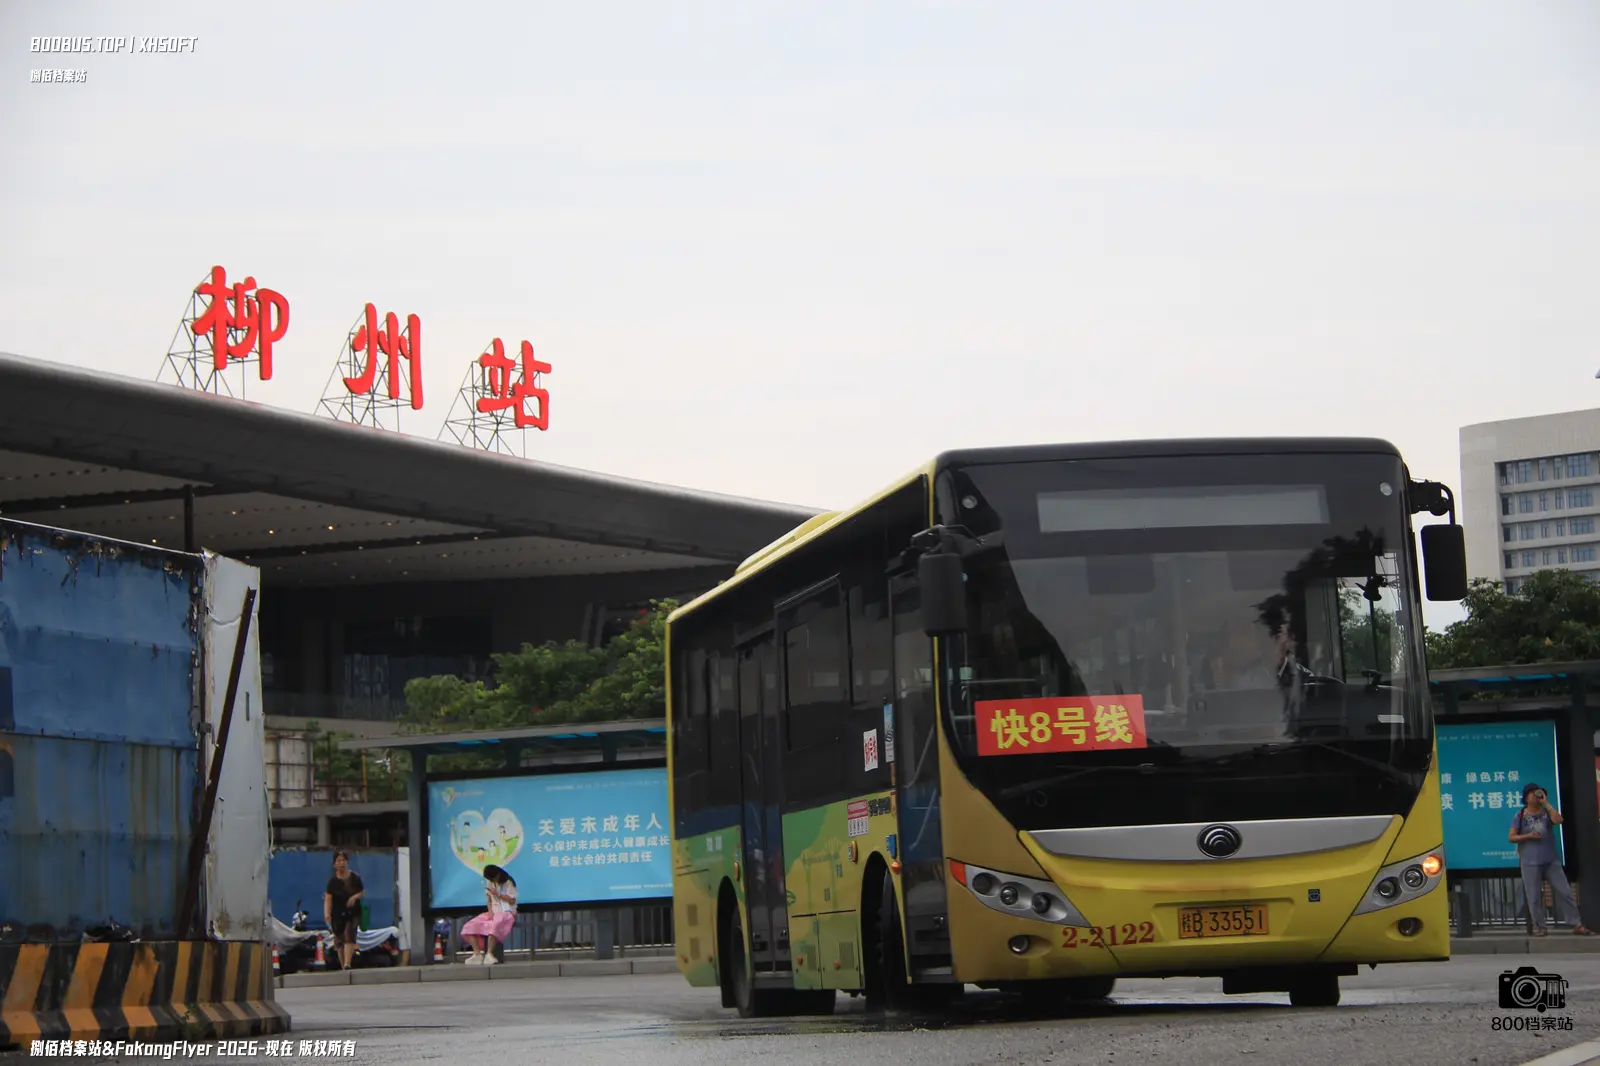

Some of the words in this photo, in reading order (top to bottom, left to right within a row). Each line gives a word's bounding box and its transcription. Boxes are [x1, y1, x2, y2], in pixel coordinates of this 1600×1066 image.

[190, 265, 552, 431] 柳州站
[990, 704, 1133, 749] 快8号线
[1466, 770, 1519, 783] 绿色环保
[538, 812, 662, 836] 关爱未成年人
[532, 835, 670, 853] 关心保护未成年人健康成长
[549, 851, 652, 867] 是全社会的共同责任
[1061, 921, 1155, 949] 2-2122
